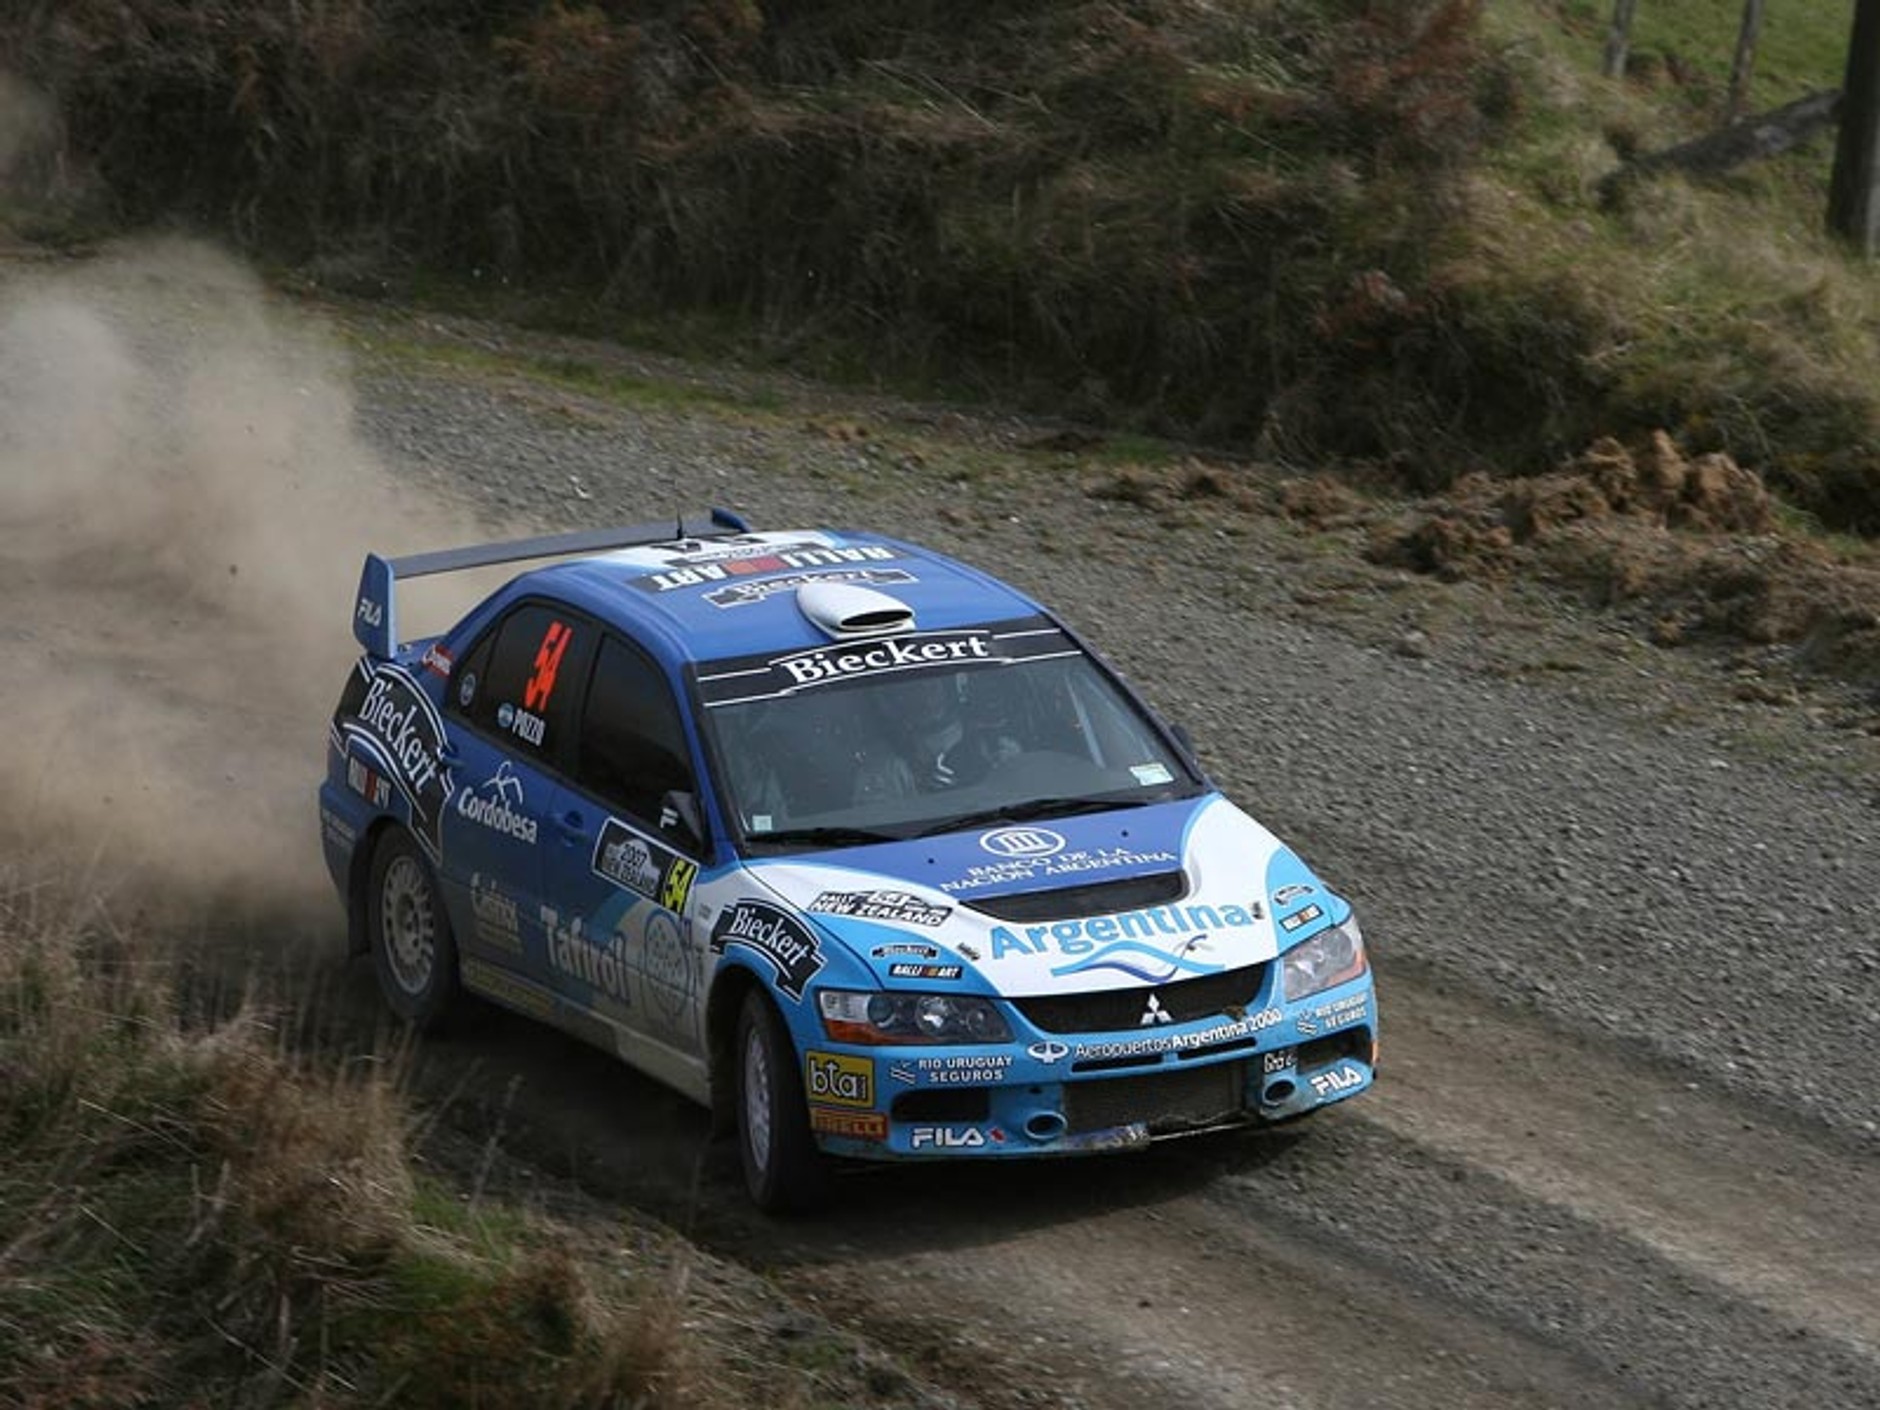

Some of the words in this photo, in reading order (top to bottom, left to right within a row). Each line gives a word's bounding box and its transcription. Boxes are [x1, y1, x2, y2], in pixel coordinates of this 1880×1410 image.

[651, 565, 727, 591] ART
[357, 598, 382, 627] FILA
[525, 620, 573, 712] 54
[780, 634, 989, 686] Bieckert
[359, 677, 437, 795] Bieckert
[458, 786, 538, 845] Cordobesa
[967, 857, 1052, 877] BANCO
[1060, 850, 1091, 863] DE
[1100, 847, 1130, 858] LA
[1046, 852, 1177, 876] ARGENTINA
[664, 858, 695, 914] 54
[811, 901, 855, 913] NEW
[855, 904, 943, 926] ZEALAND
[728, 906, 810, 967] Bieckert
[990, 902, 1254, 960] Argentina
[918, 1058, 942, 1070] RIO
[947, 1056, 1013, 1069] URUGUAY
[929, 1068, 1004, 1083] SEGUROS
[1311, 1066, 1362, 1096] FILA
[912, 1127, 985, 1148] FILA
